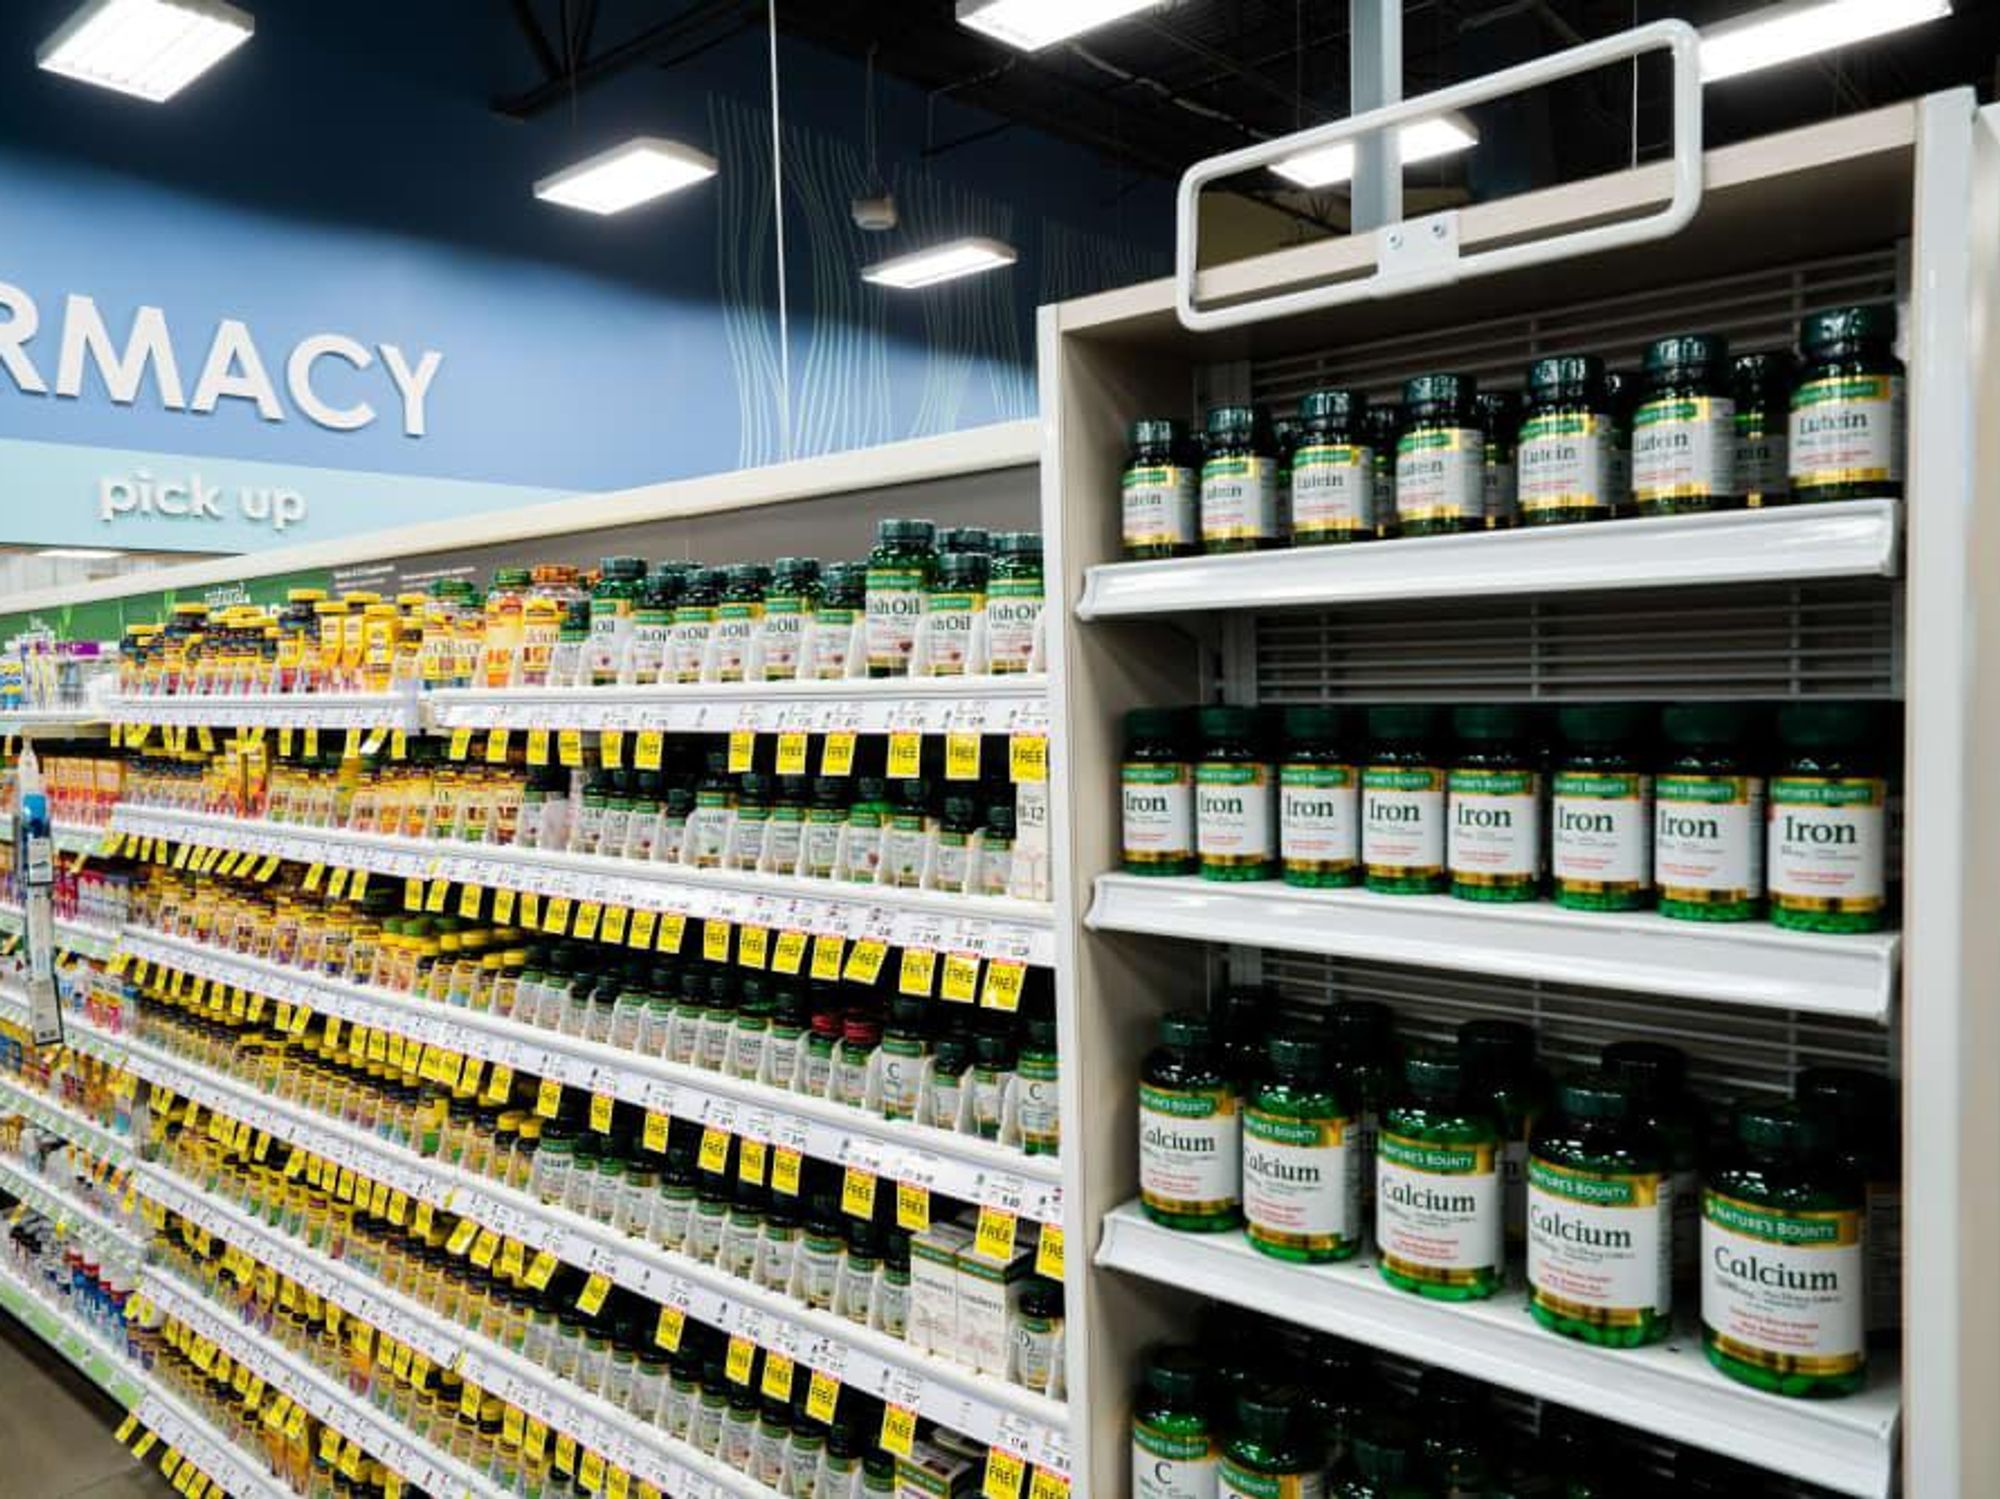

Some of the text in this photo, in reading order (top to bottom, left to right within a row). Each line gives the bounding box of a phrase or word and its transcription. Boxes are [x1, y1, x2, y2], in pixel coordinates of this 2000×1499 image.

[98, 466, 308, 531] pick up
[1125, 790, 1167, 813] Iron
[1199, 791, 1243, 814] Iron
[1287, 793, 1334, 817] Iron
[1370, 797, 1420, 822] Iron
[1458, 802, 1512, 828] Iron
[1558, 805, 1614, 832] Iron
[1660, 809, 1719, 838] Iron
[1785, 815, 1856, 844] Iron
[1029, 1083, 1043, 1100] C
[1382, 1174, 1476, 1213] Calcium
[1577, 1182, 1629, 1199] BOUNTY
[1530, 1203, 1632, 1249] Calcium
[1776, 1221, 1835, 1239] BOUNTY
[1714, 1245, 1838, 1292] Calcium
[1155, 1461, 1172, 1485] C
